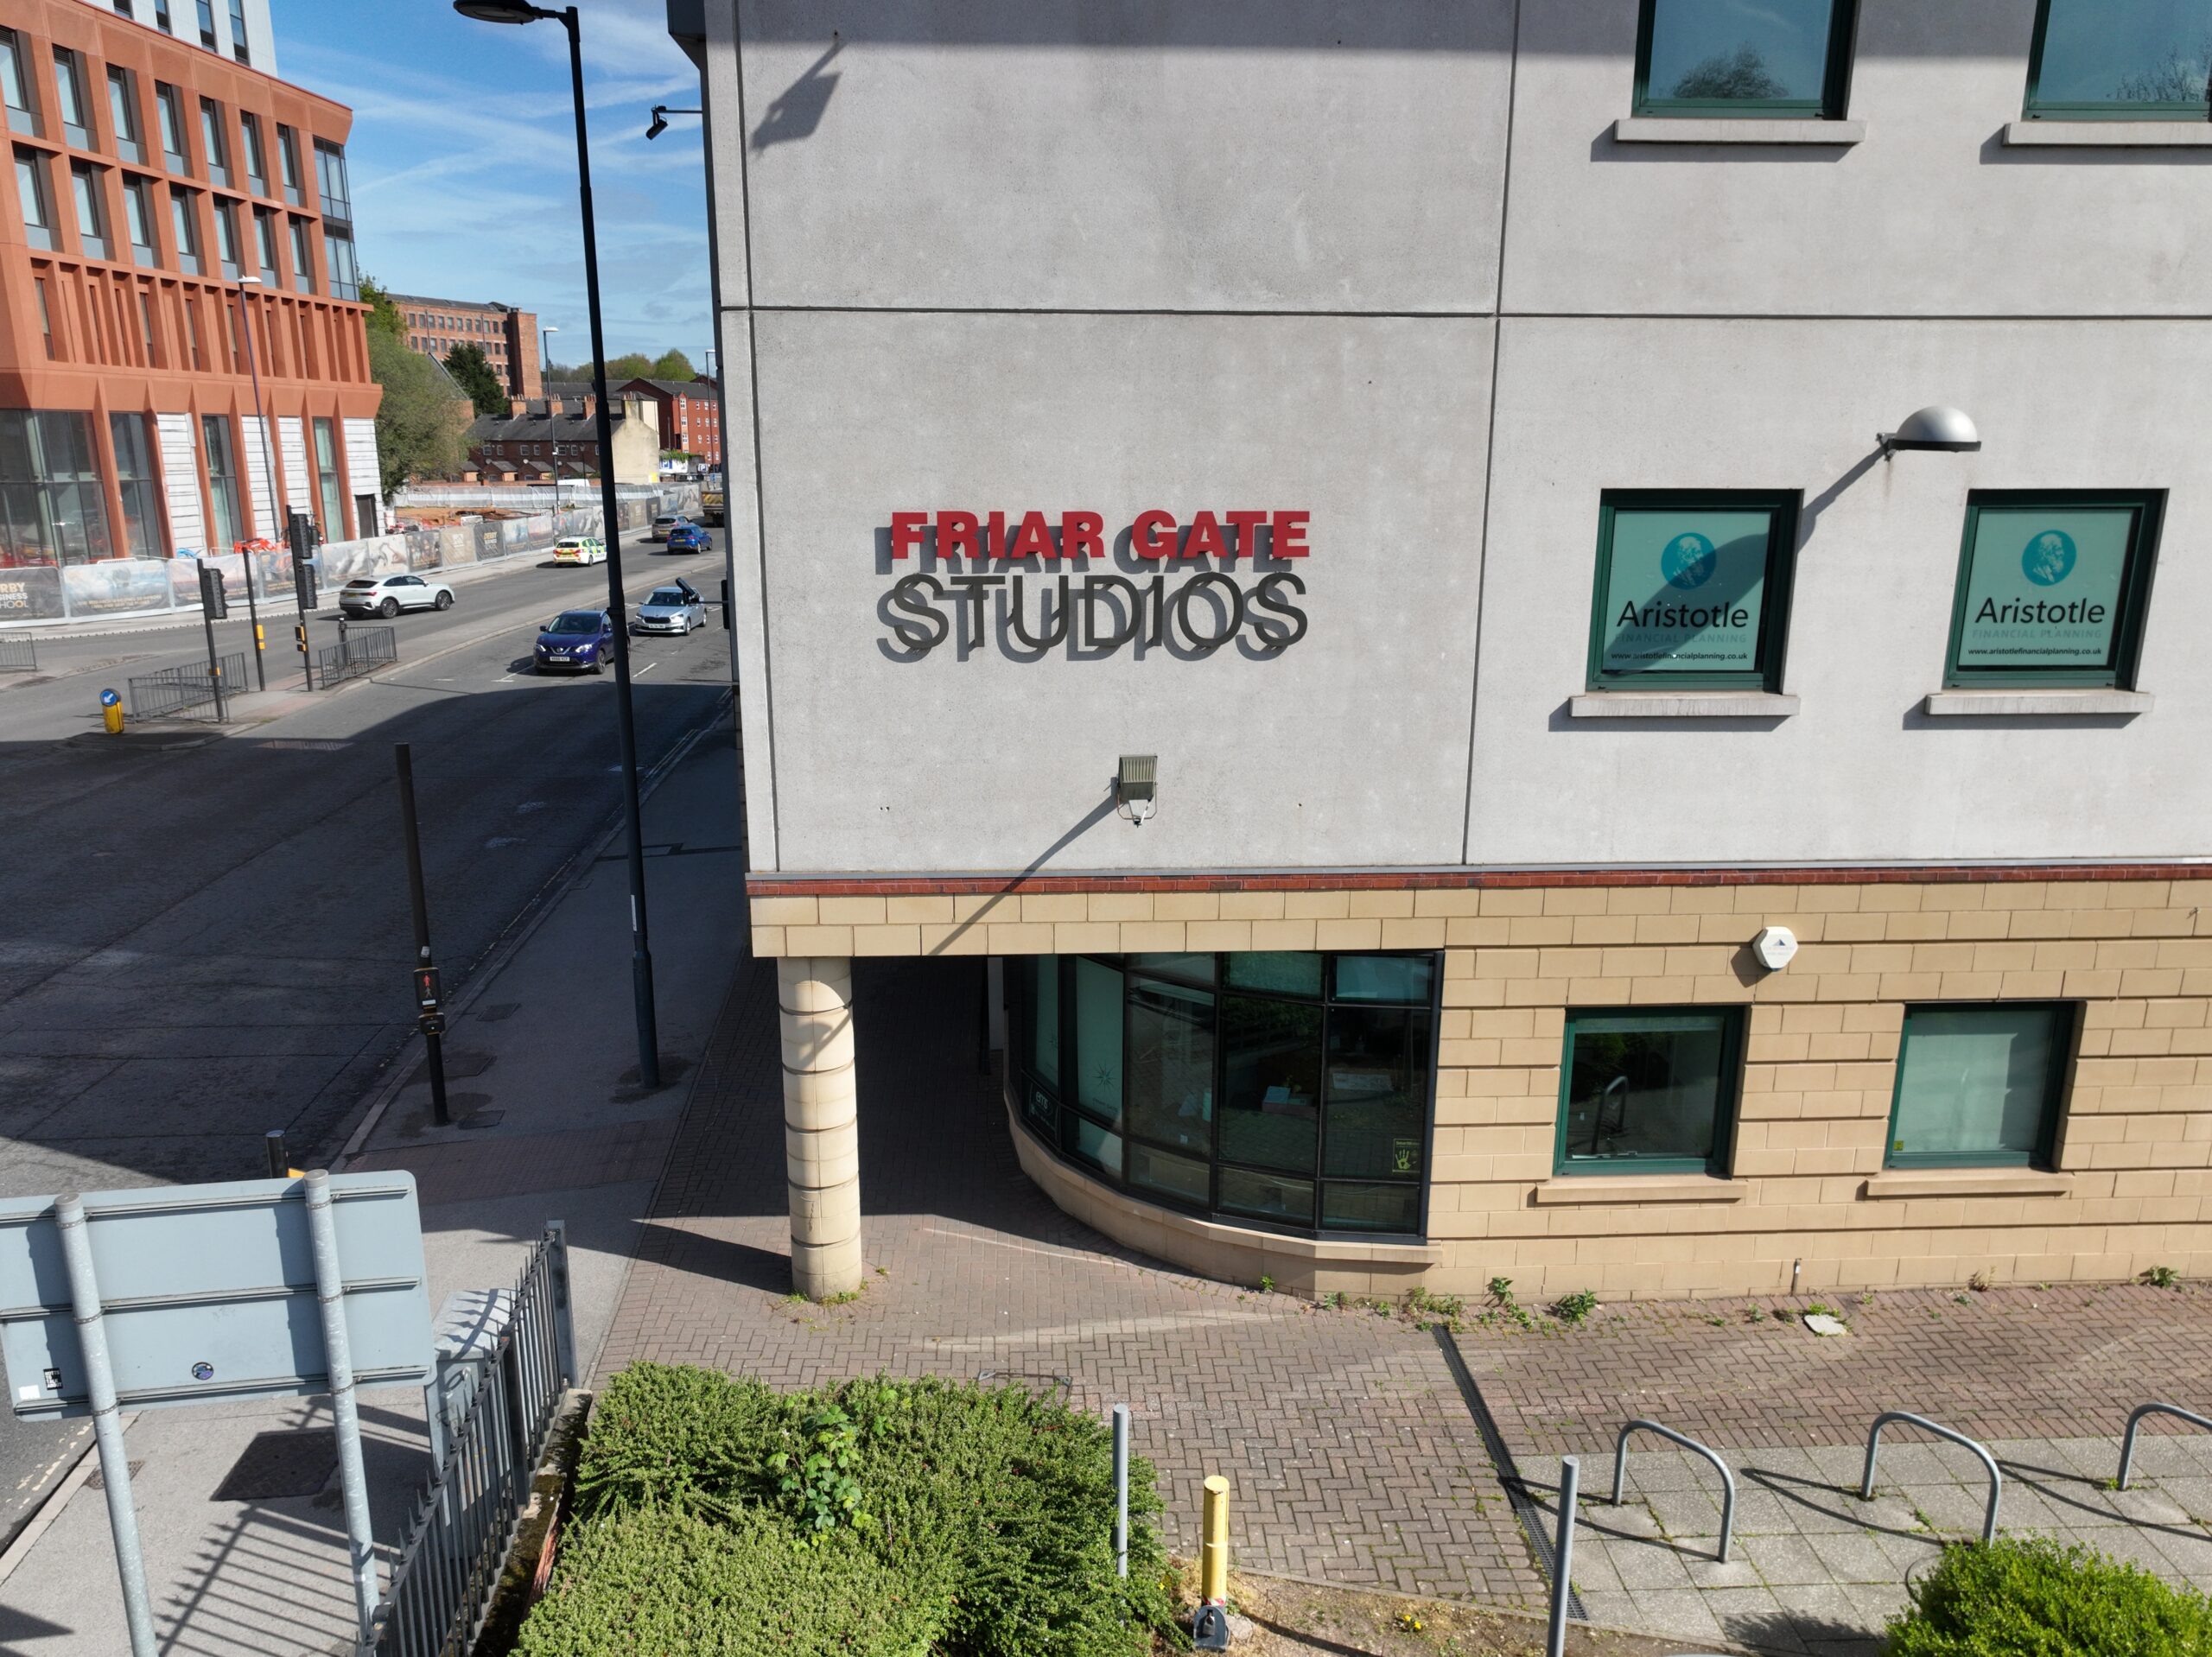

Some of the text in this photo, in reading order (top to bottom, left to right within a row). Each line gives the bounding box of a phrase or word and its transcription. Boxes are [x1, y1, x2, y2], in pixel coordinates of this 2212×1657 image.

[892, 510, 1310, 560] FRIAR GATE
[893, 572, 1308, 649] STUDIOS
[1617, 600, 1748, 628] Aristotle
[1975, 597, 2105, 624] Aristotle
[1972, 629, 2102, 638] FINANCIAL PLANNING
